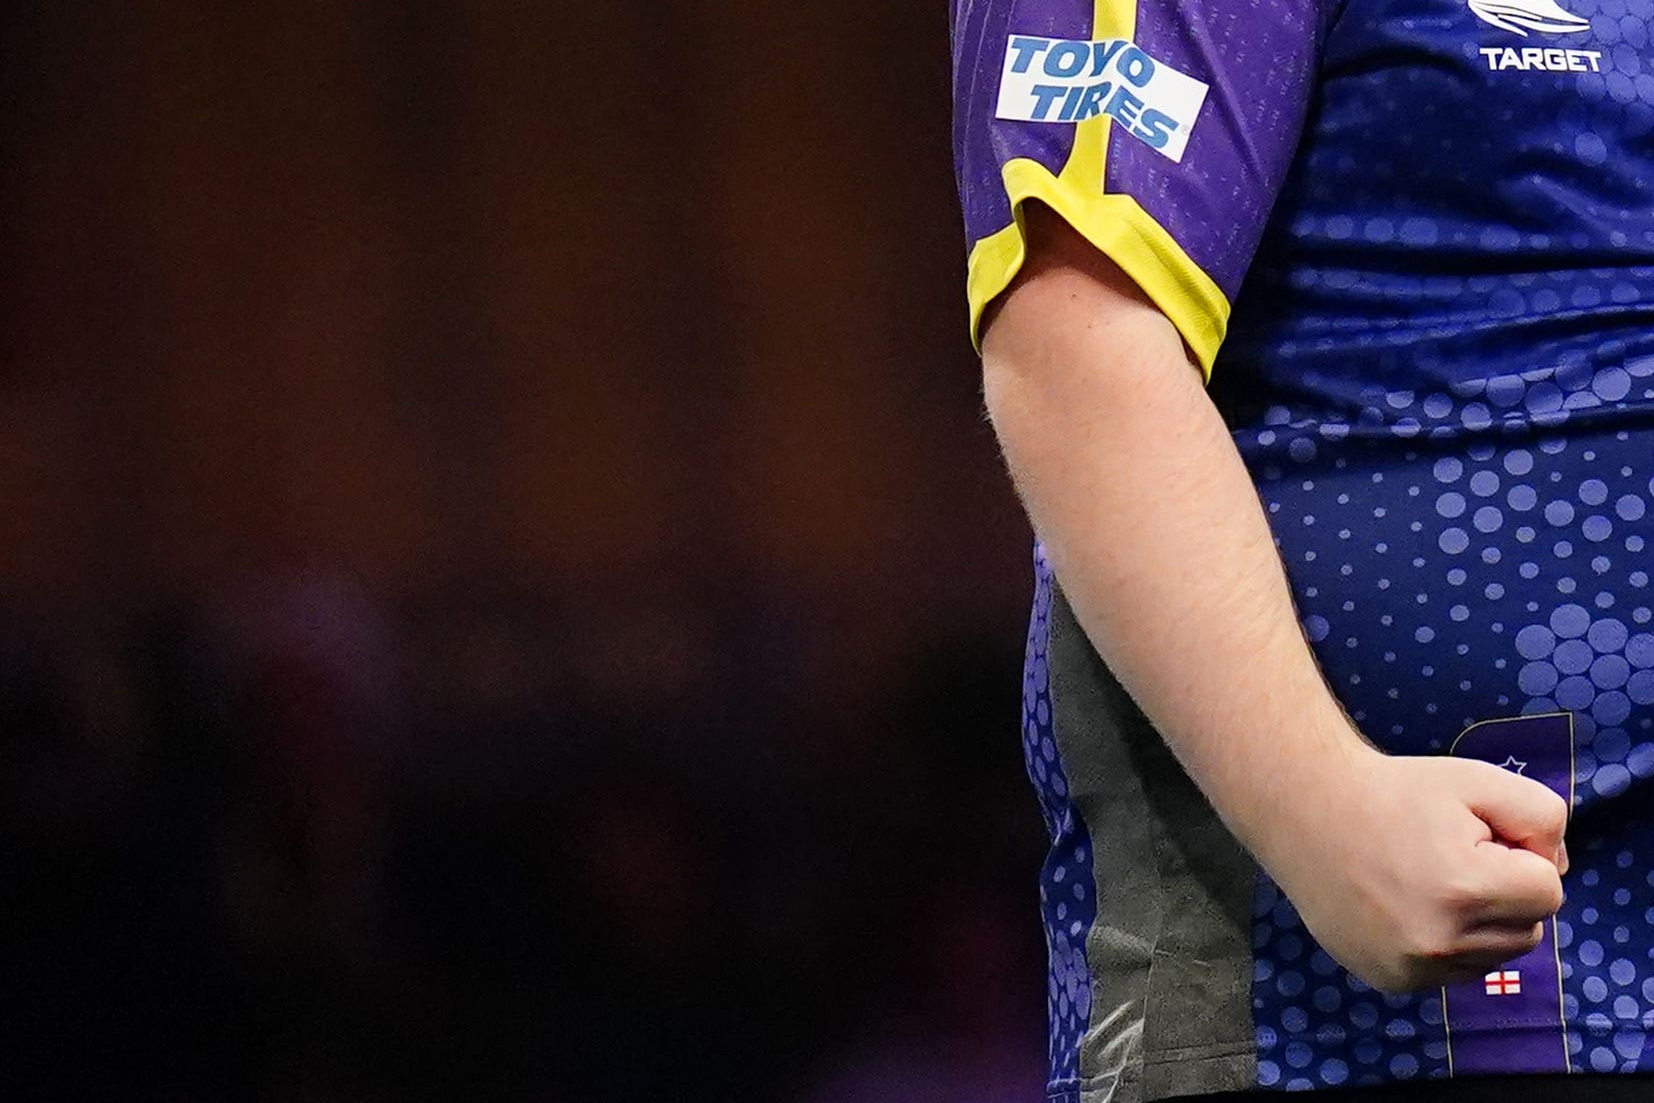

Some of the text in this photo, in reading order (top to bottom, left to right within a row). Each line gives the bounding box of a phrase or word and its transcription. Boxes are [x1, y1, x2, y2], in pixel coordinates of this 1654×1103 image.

[1011, 38, 1156, 88] TOYO
[1479, 48, 1602, 72] TARGET
[1031, 81, 1180, 149] TIRES
